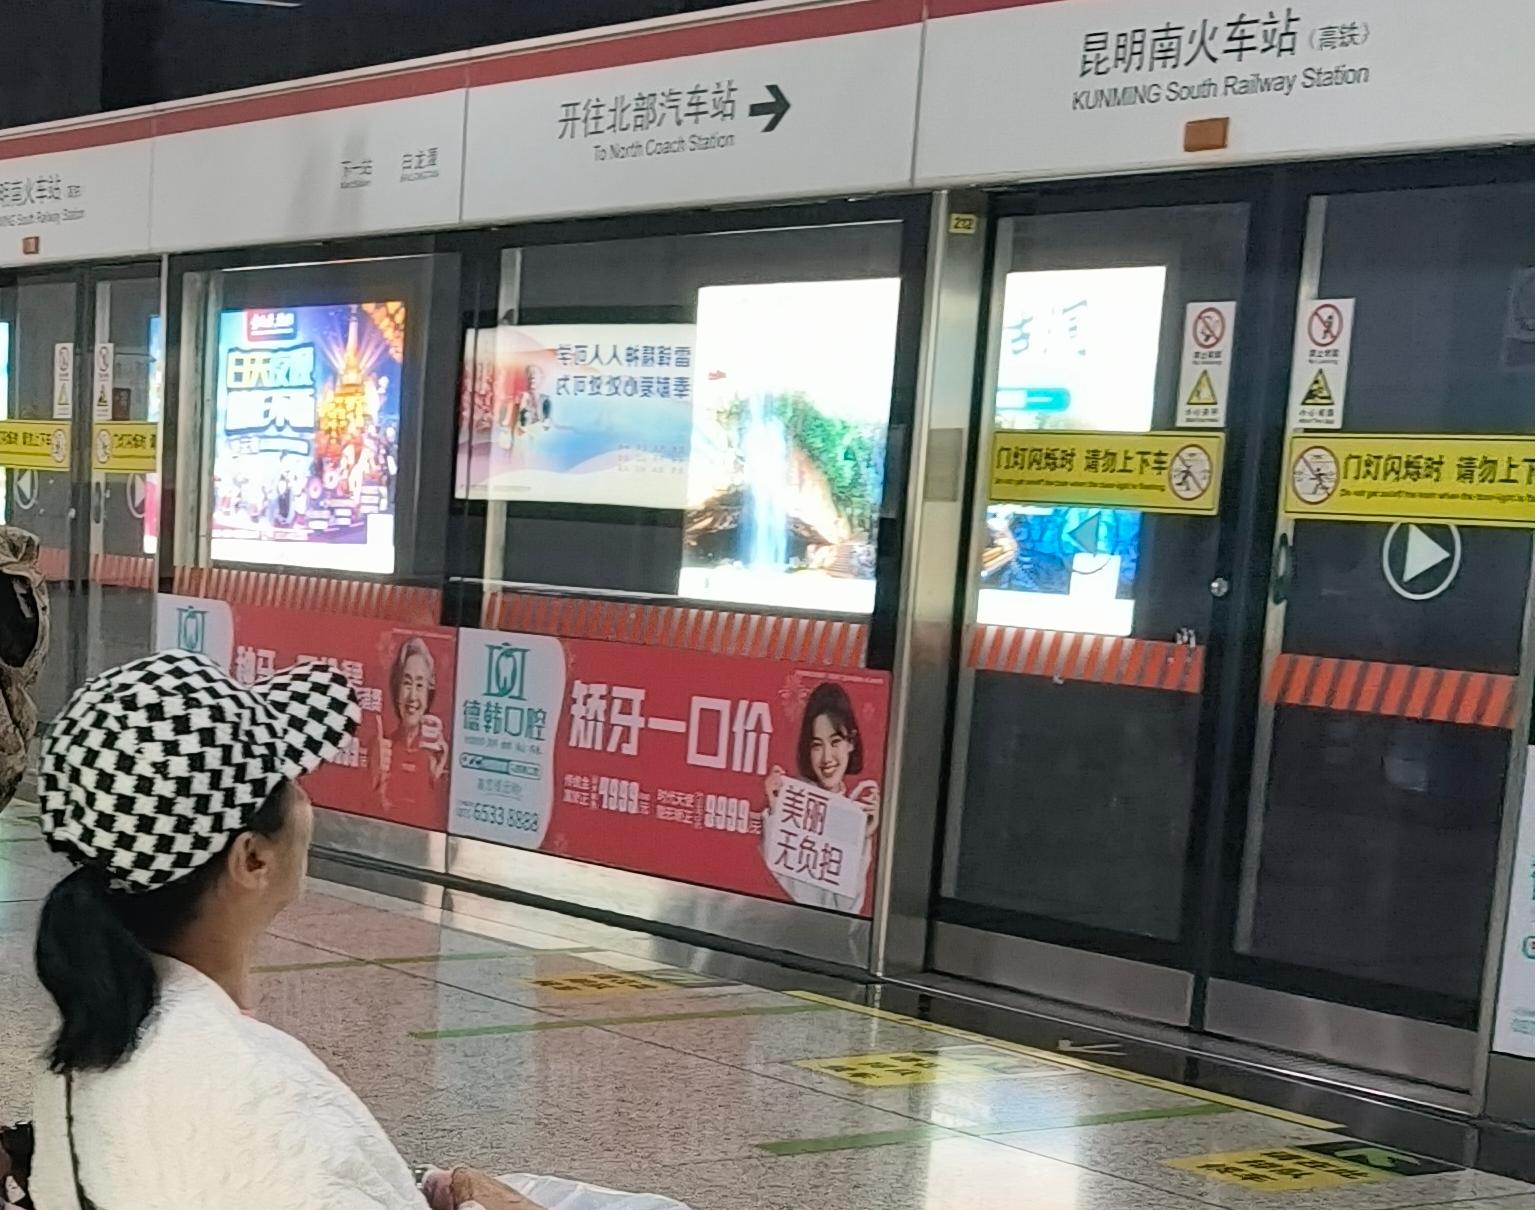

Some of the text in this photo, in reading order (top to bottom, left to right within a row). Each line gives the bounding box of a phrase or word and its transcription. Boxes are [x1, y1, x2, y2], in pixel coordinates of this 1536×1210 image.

[558, 80, 738, 139] 开往北部汽车站
[1072, 64, 1370, 110] KUNMING South Railway Station
[610, 141, 643, 160] North
[645, 137, 685, 156] Coach
[689, 134, 735, 151] Station
[996, 446, 1169, 475] 门灯闪烁时 请勿上下车
[1343, 454, 1444, 482] 门灯闪烁时
[569, 680, 773, 775] 矫牙一口价
[781, 785, 829, 835] 美丽
[774, 829, 843, 885] 无负担
